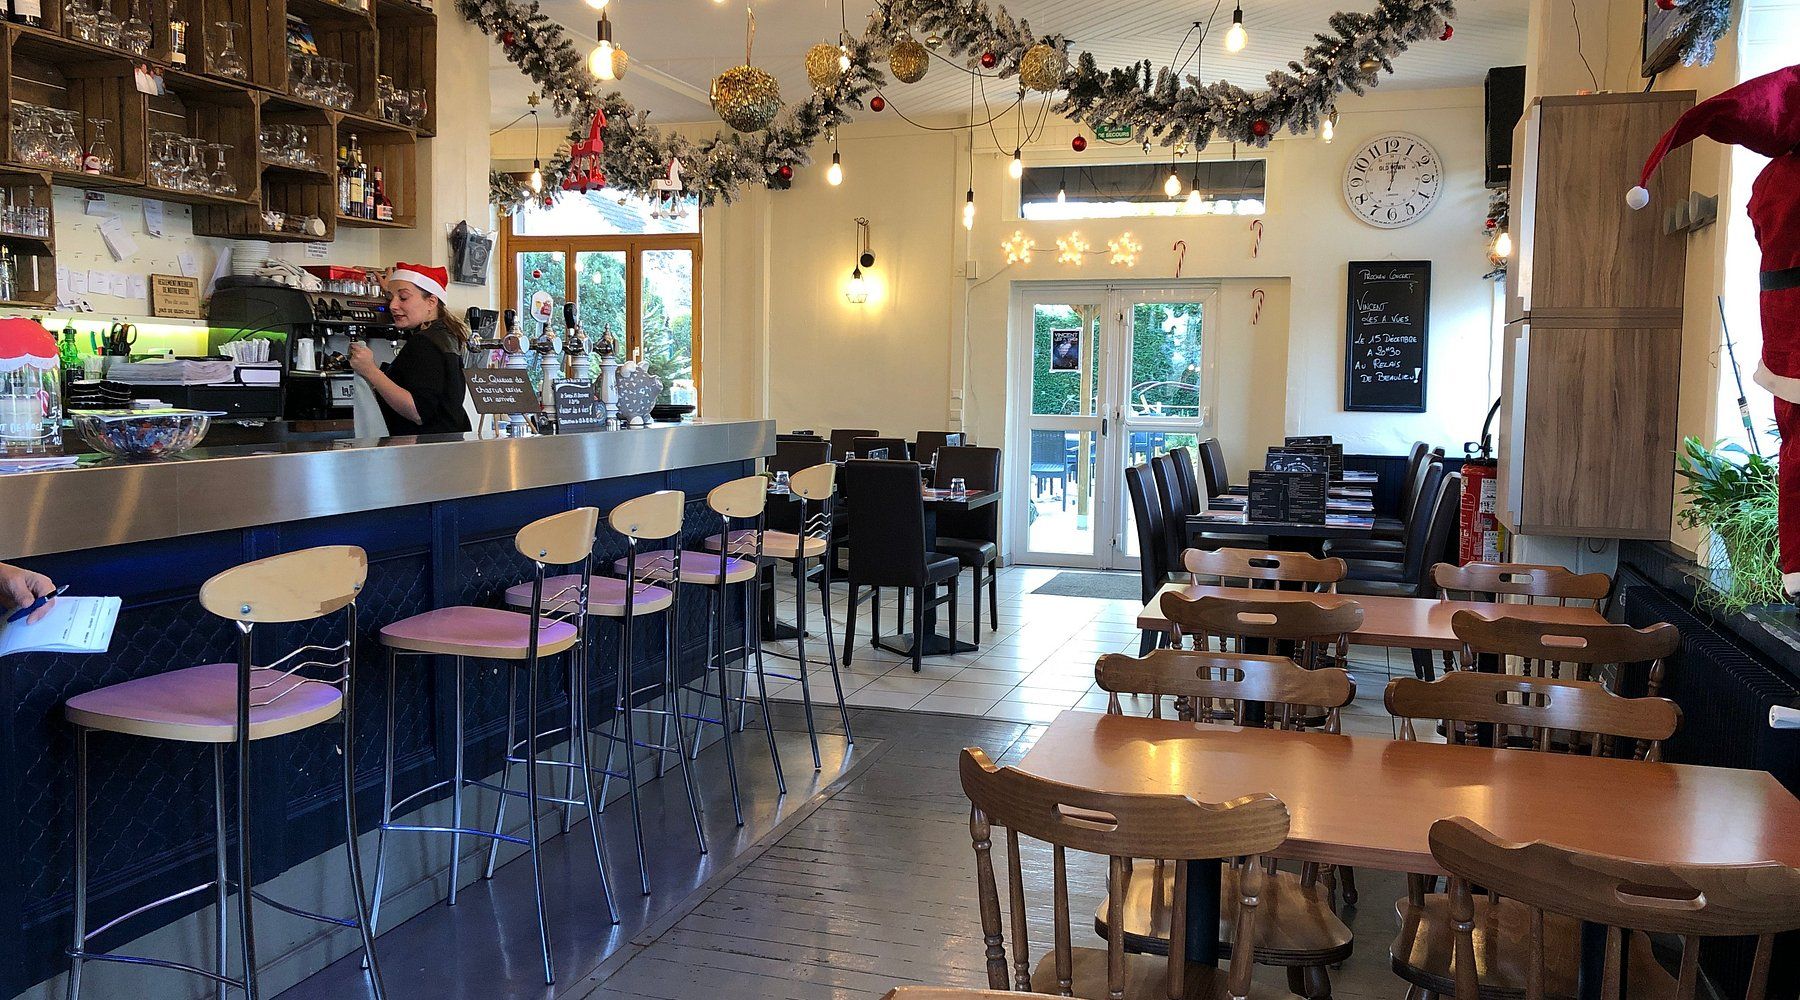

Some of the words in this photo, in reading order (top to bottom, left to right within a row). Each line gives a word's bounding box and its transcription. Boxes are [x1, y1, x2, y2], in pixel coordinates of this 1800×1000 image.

[1368, 145, 1381, 159] 11
[1384, 139, 1399, 154] 12
[1406, 144, 1414, 156] 1
[1354, 157, 1369, 173] 10
[1416, 155, 1430, 167] 2
[1350, 177, 1364, 188] 9
[1421, 173, 1435, 184] 3
[1354, 193, 1368, 206] 8
[1369, 204, 1382, 216] 7
[1387, 207, 1397, 221] 6
[1405, 202, 1415, 215] 5
[1368, 334, 1382, 344] 15
[1355, 361, 1366, 370] AU
[1373, 358, 1401, 370] RELAIS
[488, 374, 514, 384] Queue
[1360, 374, 1372, 383] DE
